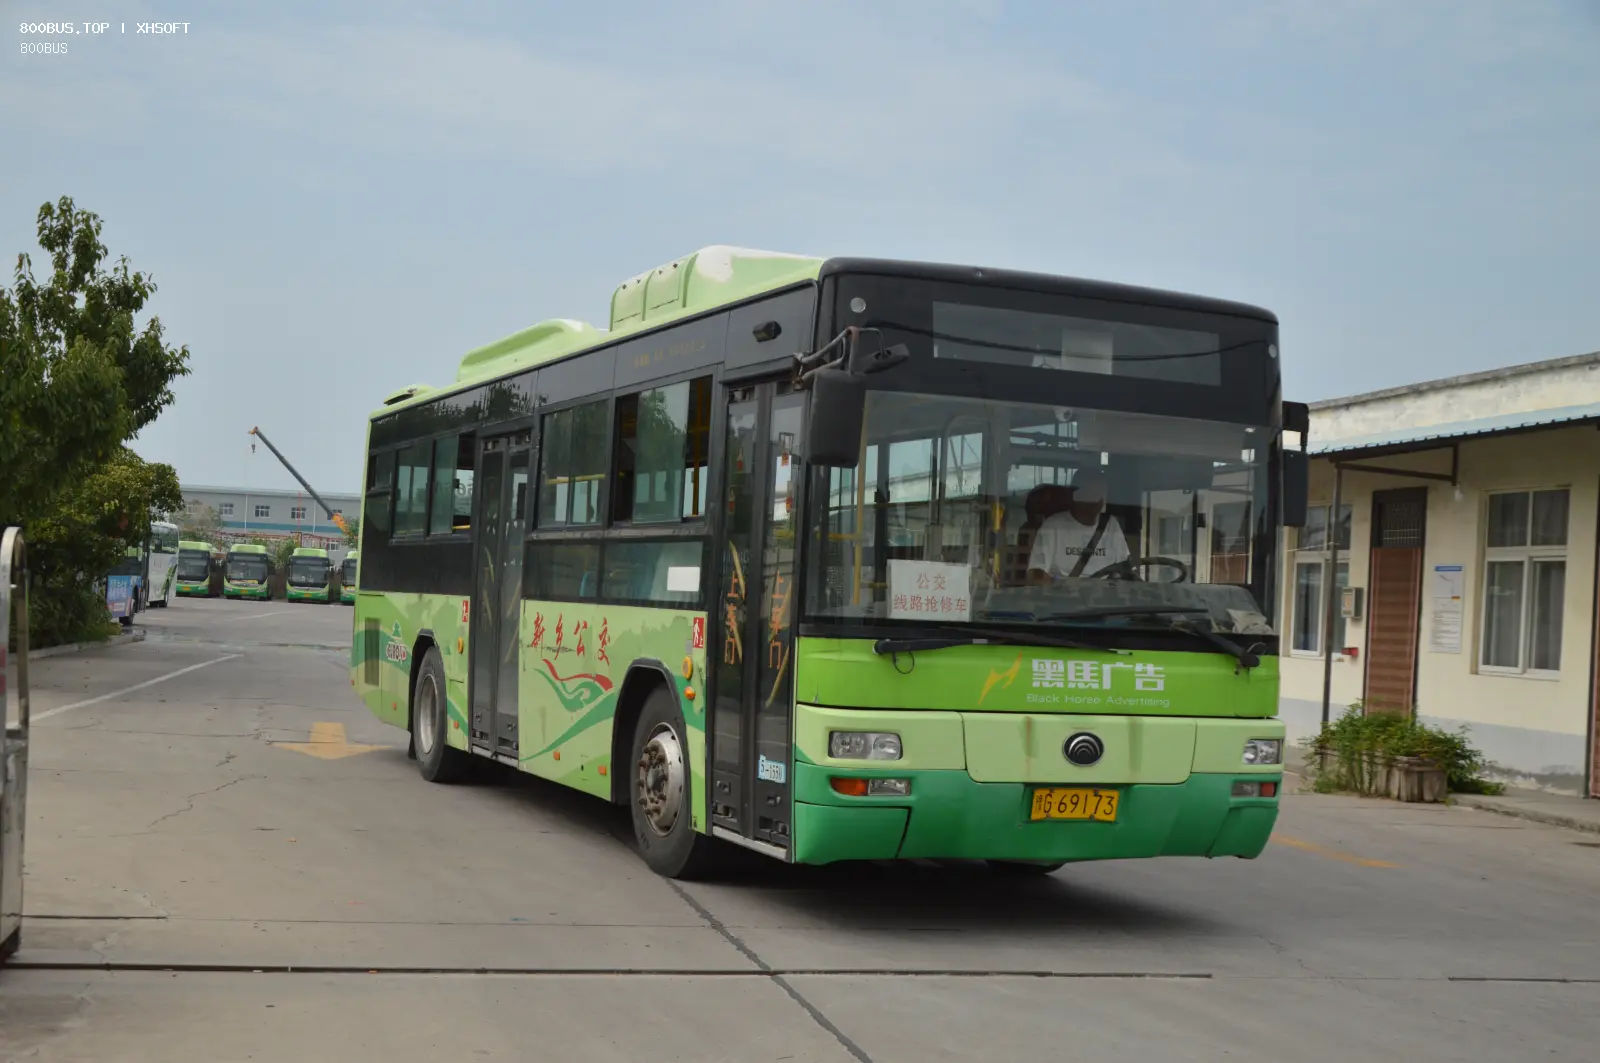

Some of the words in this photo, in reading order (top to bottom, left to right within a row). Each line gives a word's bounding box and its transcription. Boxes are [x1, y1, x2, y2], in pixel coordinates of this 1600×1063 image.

[1065, 547, 1107, 557] DESNTE
[916, 571, 946, 591] 公交
[893, 593, 967, 613] 线路抢修车
[530, 611, 611, 666] 新乡公交
[1026, 693, 1060, 704] Black
[1065, 695, 1101, 705] Horse
[1106, 695, 1171, 709] Advertising
